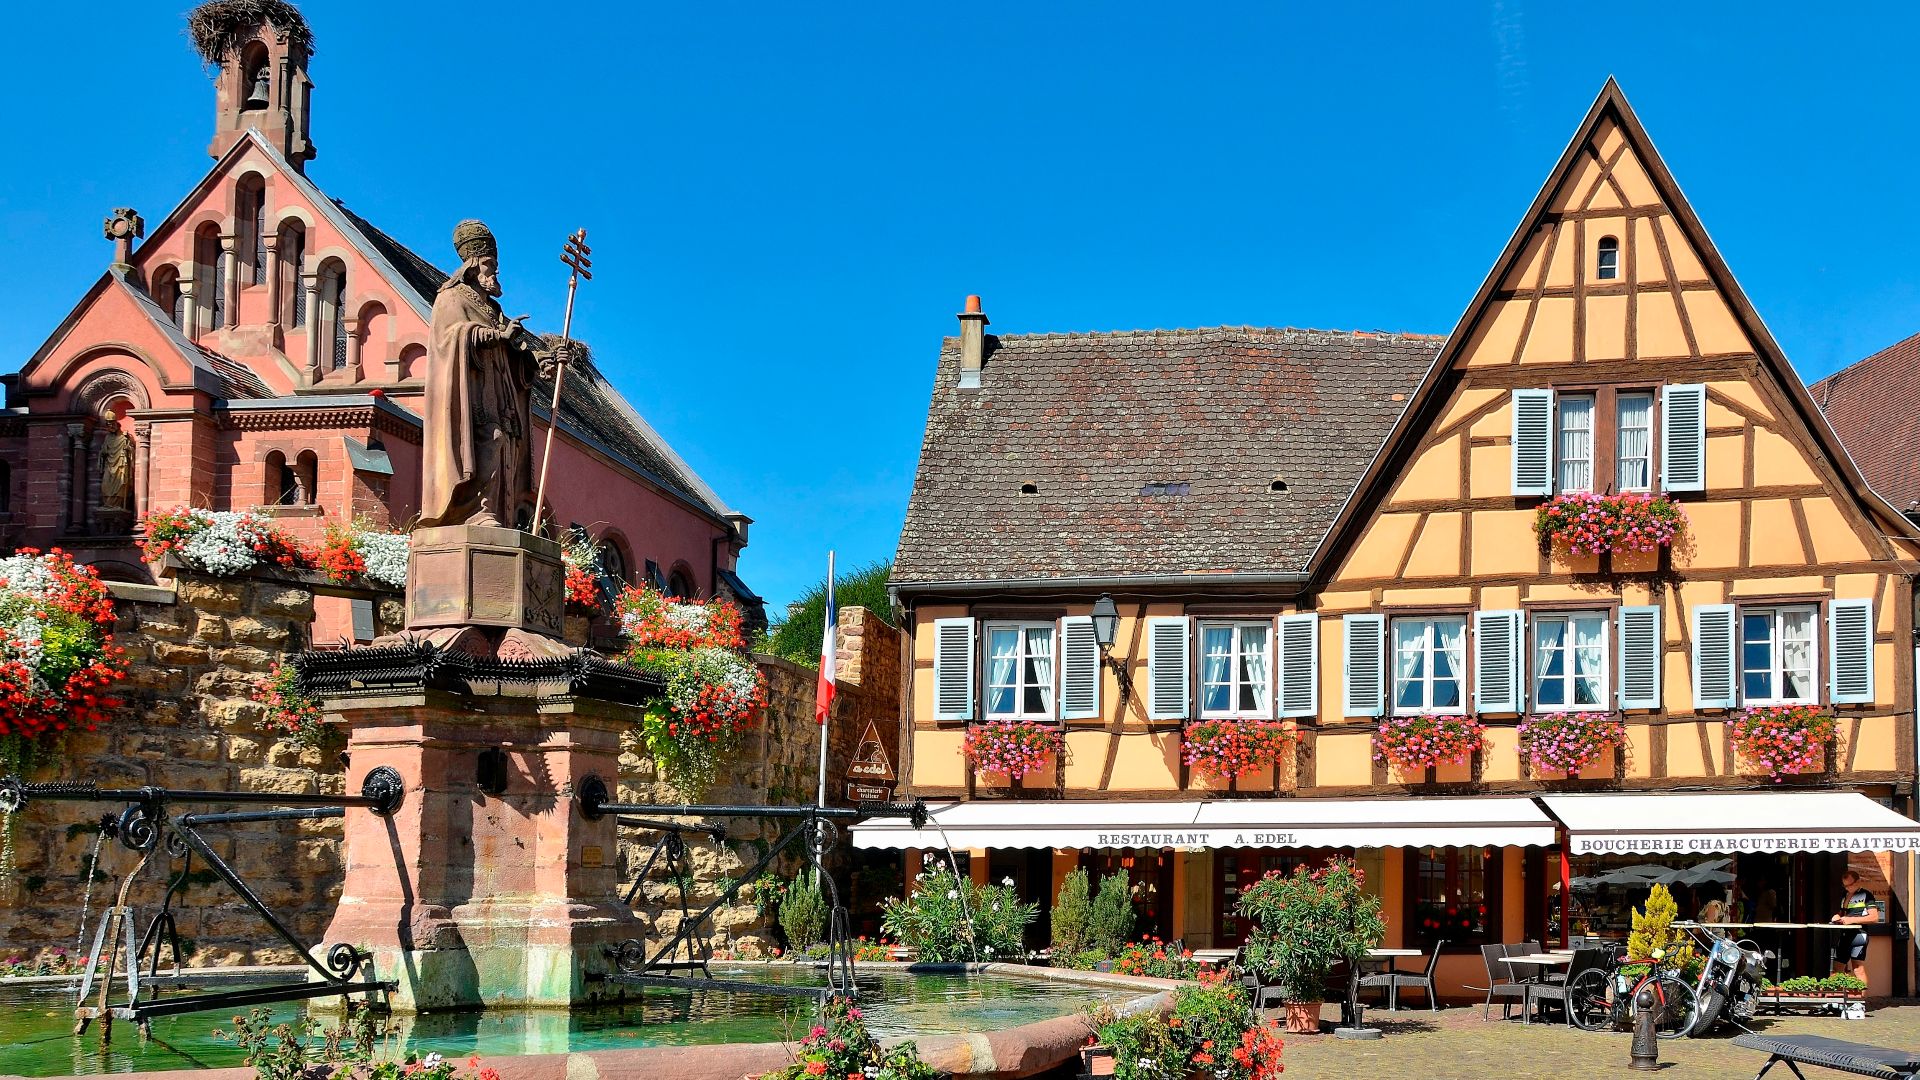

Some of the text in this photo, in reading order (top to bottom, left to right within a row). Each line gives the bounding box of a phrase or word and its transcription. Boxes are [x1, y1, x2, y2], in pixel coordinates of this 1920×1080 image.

[1097, 832, 1298, 845] RESTAURANT A. EDEL
[1580, 836, 1920, 851] BOUCHERIE CHARCUTERIE TRAITEUR
